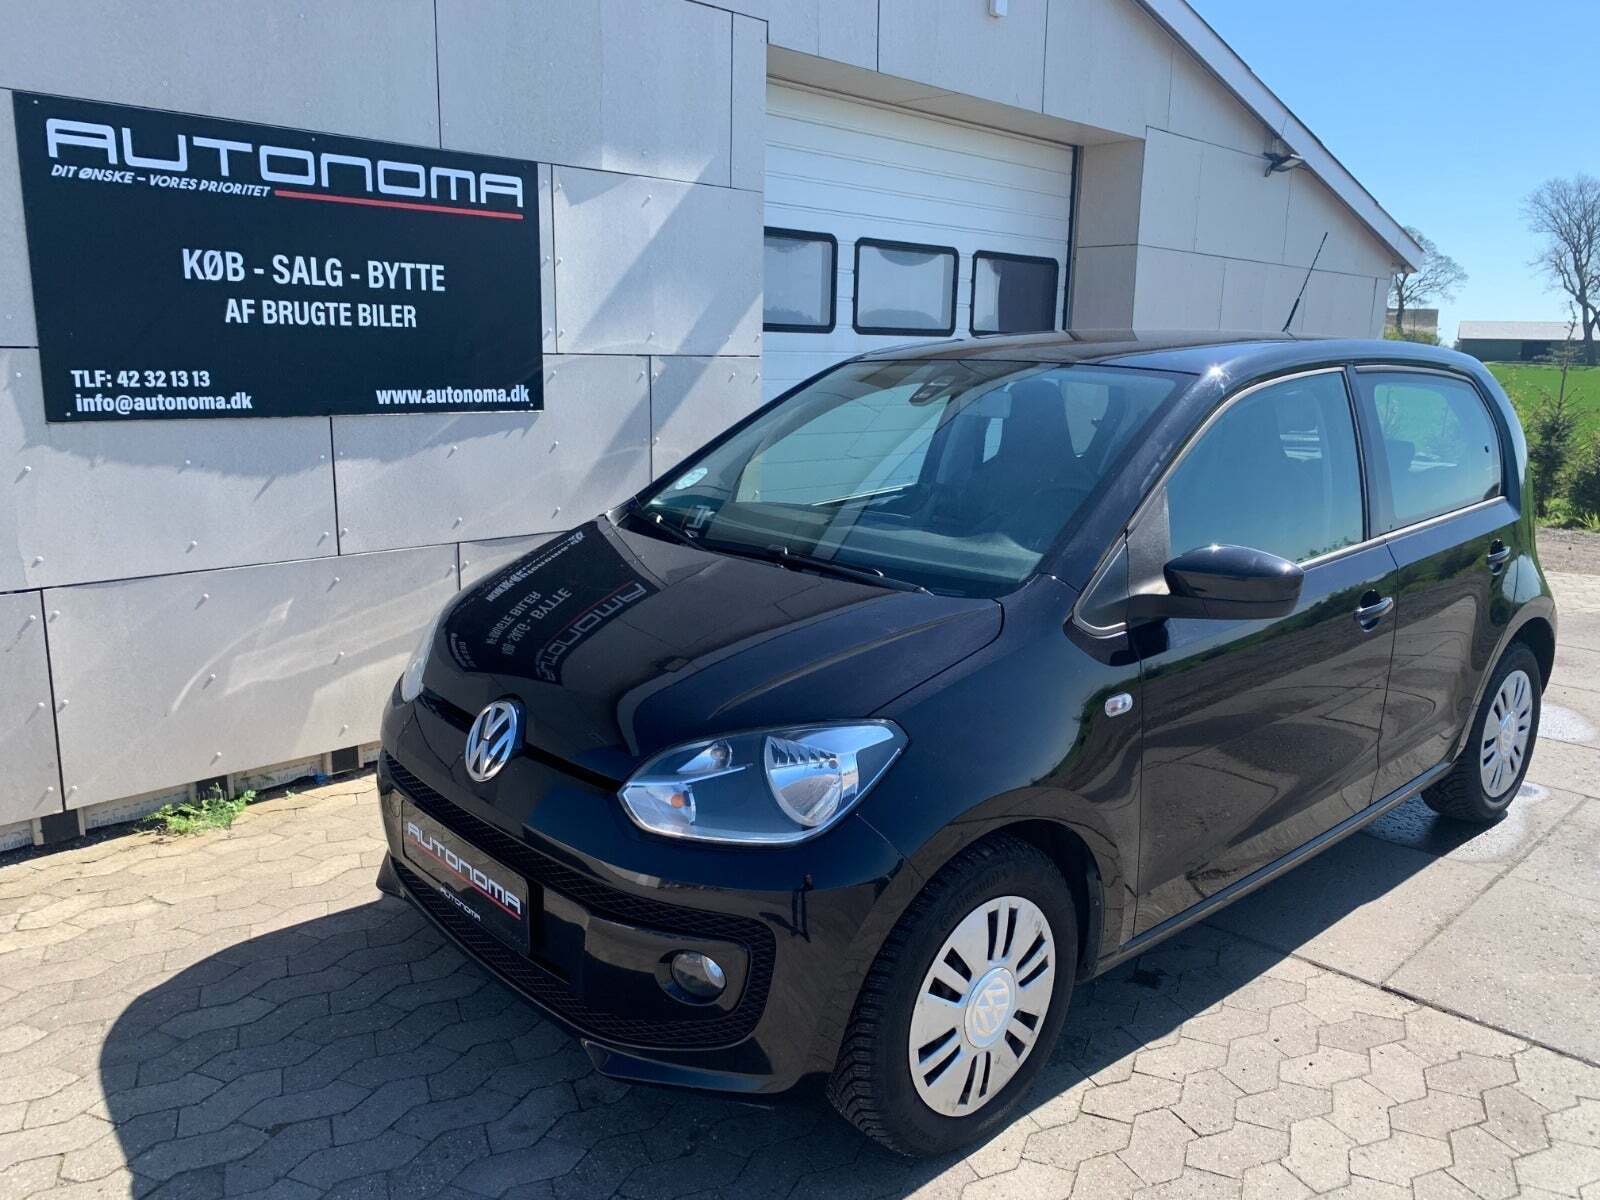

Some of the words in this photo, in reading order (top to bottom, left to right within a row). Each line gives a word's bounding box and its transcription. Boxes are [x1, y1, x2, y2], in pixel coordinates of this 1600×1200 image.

[46, 118, 524, 208] AUTONOMA
[51, 163, 78, 179] DIT
[78, 167, 135, 184] ØNSKE
[149, 173, 198, 191] VORES
[199, 179, 271, 197] PRIORITET
[182, 248, 246, 282] KØB
[253, 267, 265, 275] -
[272, 254, 343, 287] SALG
[350, 272, 361, 280] -
[367, 260, 446, 292] BYTTE
[225, 298, 256, 324] AF
[261, 299, 353, 327] BRUGTE
[357, 303, 417, 328] BILER
[70, 369, 113, 388] TLF:
[116, 370, 141, 388] 42
[143, 370, 168, 388] 32
[170, 369, 189, 388] 13
[191, 369, 211, 388] 13
[375, 384, 530, 405] www.autonoma.dk
[75, 391, 253, 415] info@autonoma.dk
[407, 821, 522, 915] AUTONOMA
[439, 886, 481, 922] AUTONOMA
